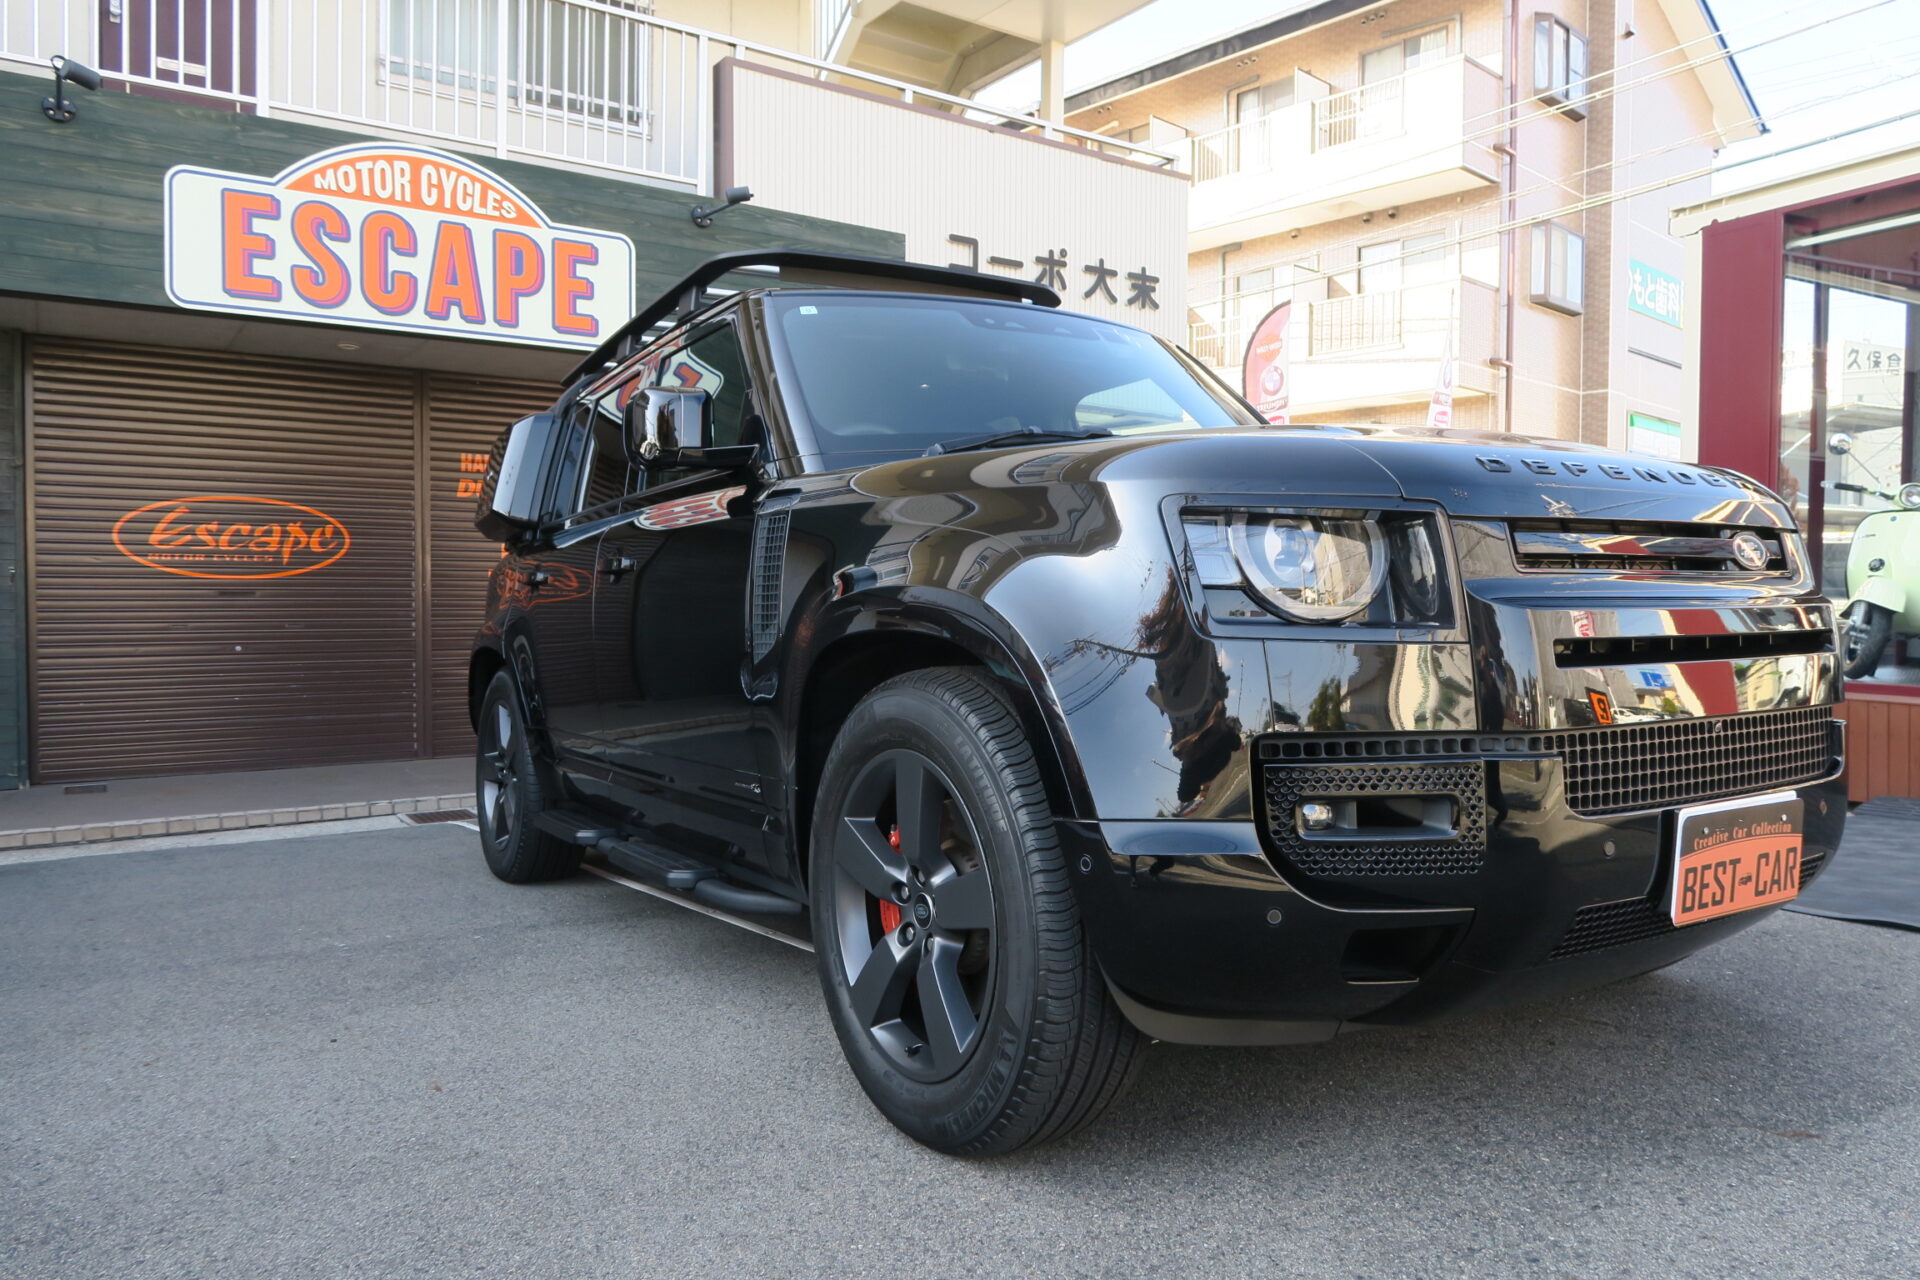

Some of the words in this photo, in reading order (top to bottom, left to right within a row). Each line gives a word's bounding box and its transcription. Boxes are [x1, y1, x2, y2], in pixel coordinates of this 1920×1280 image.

[313, 159, 412, 203] MOTOR
[420, 163, 518, 220] CYCLES
[221, 187, 599, 337] ESCAPE
[147, 505, 340, 566] Escape
[1694, 831, 1729, 851] Creative
[1733, 826, 1748, 839] Car
[1751, 821, 1792, 836] Collection
[1681, 857, 1742, 914] BEST
[1754, 846, 1798, 897] CAR
